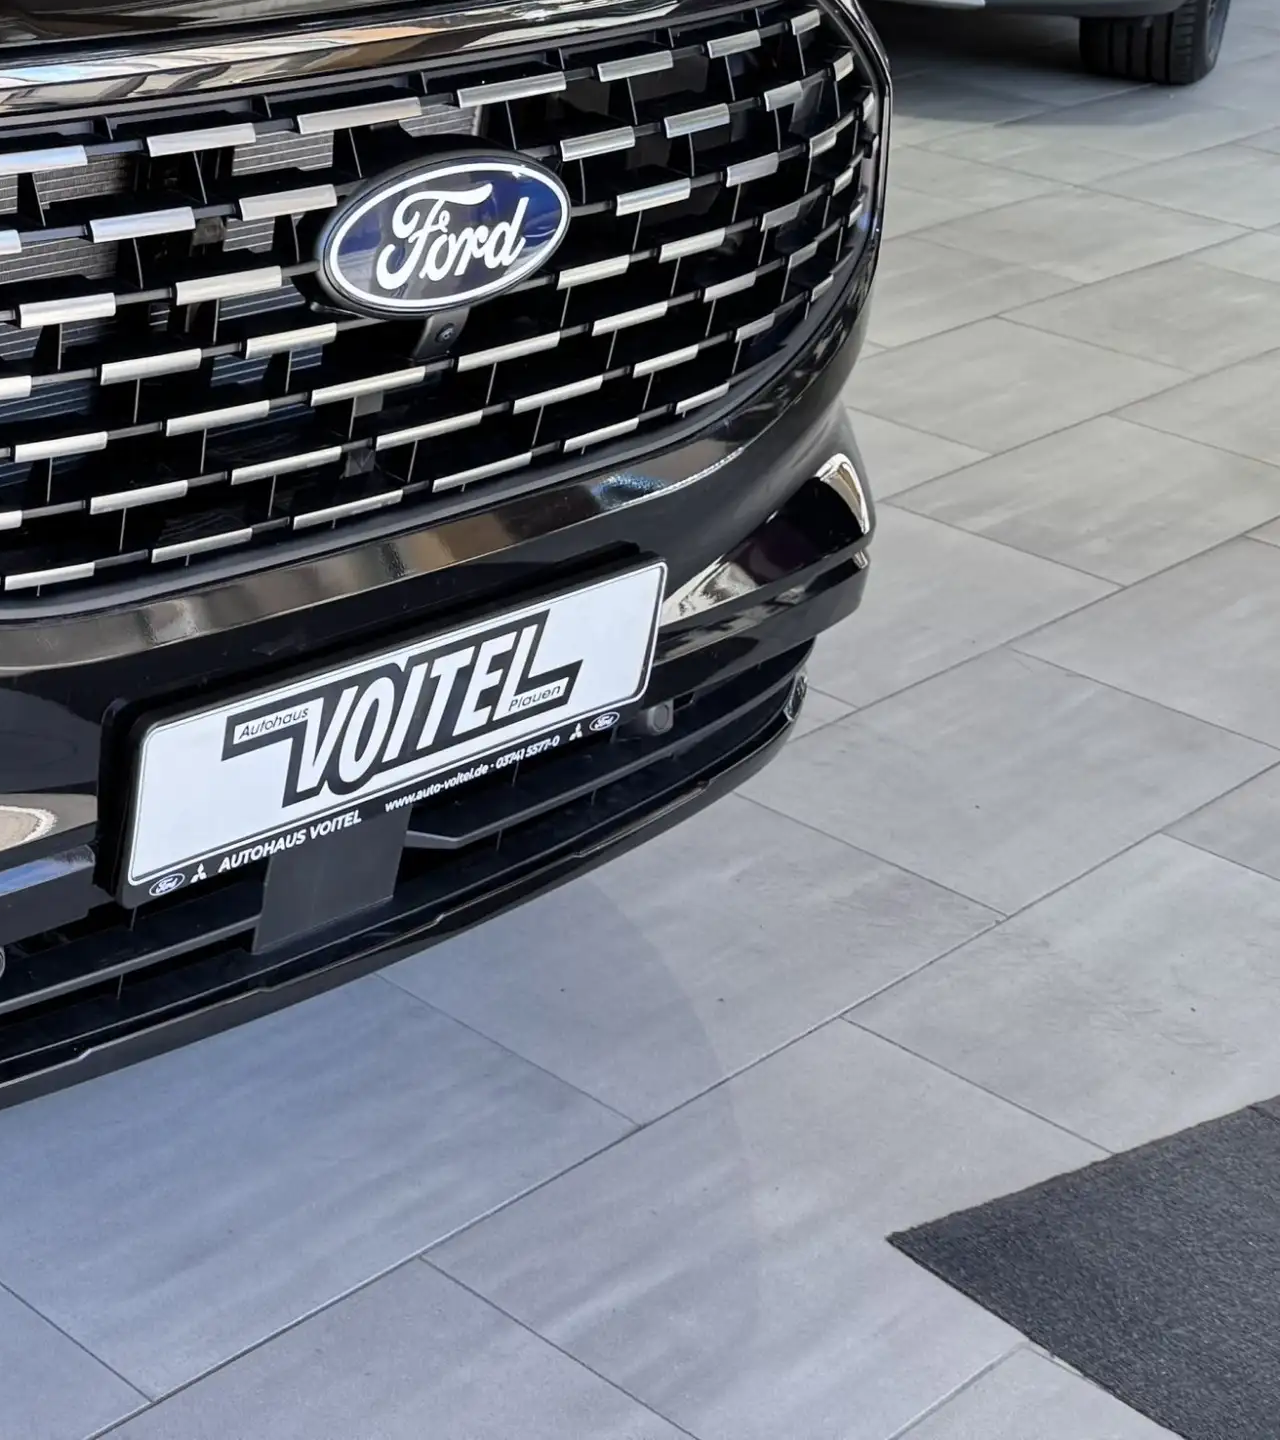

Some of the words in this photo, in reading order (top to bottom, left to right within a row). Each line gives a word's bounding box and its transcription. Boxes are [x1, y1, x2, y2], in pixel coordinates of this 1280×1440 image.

[375, 182, 531, 291] Ford
[237, 705, 310, 741] Autohaus
[296, 623, 545, 797] VOITEL
[507, 684, 562, 713] Plauen
[384, 764, 489, 813] www.auto-voitel.de
[495, 750, 526, 770] 03741
[525, 734, 561, 758] 5577-0
[218, 830, 307, 874] AUTOHAUS
[309, 809, 362, 841] VOITEL
